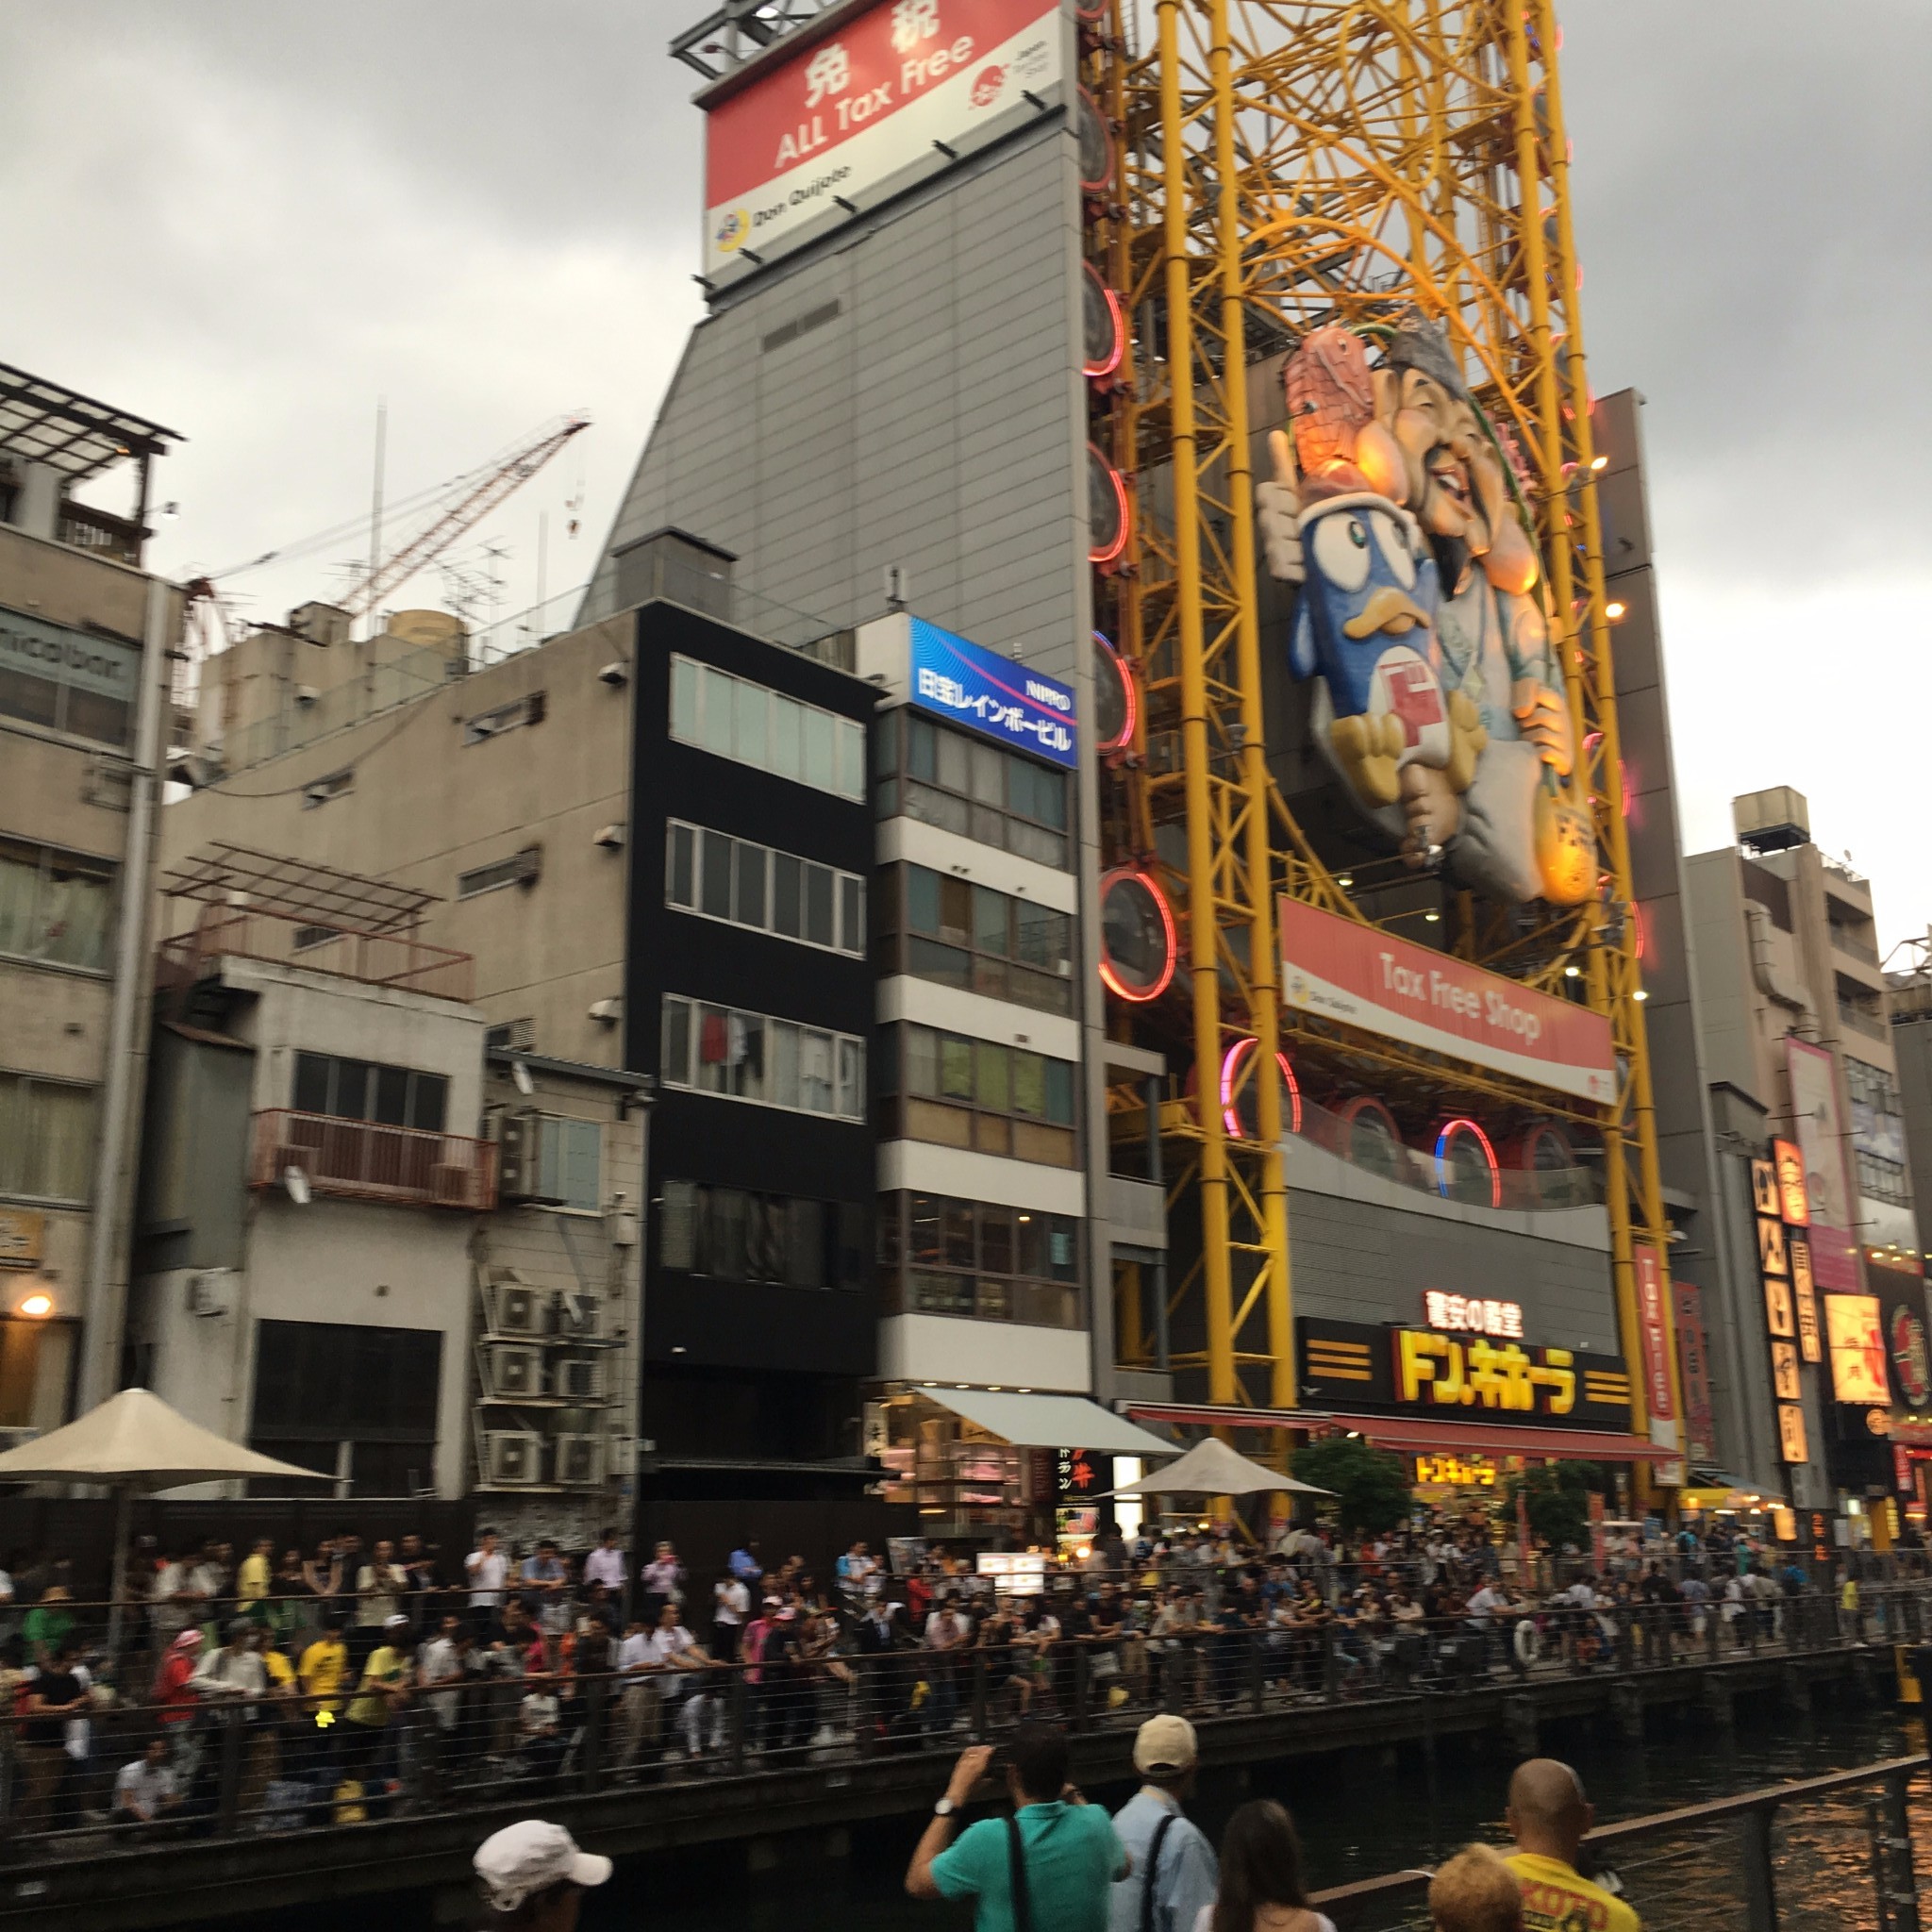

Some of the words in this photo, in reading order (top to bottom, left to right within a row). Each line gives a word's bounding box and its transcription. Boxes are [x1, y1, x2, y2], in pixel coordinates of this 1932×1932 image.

[774, 121, 828, 169] ALL
[834, 81, 892, 132] Tax
[900, 34, 975, 94] Free
[753, 202, 786, 228] Don
[788, 166, 852, 207] Quijote
[918, 667, 1072, 752] 日宝レインボービル
[1379, 951, 1427, 1003] Tax
[1429, 969, 1481, 1020] Free
[1484, 990, 1541, 1046] Shop
[1642, 1258, 1660, 1320] Tax
